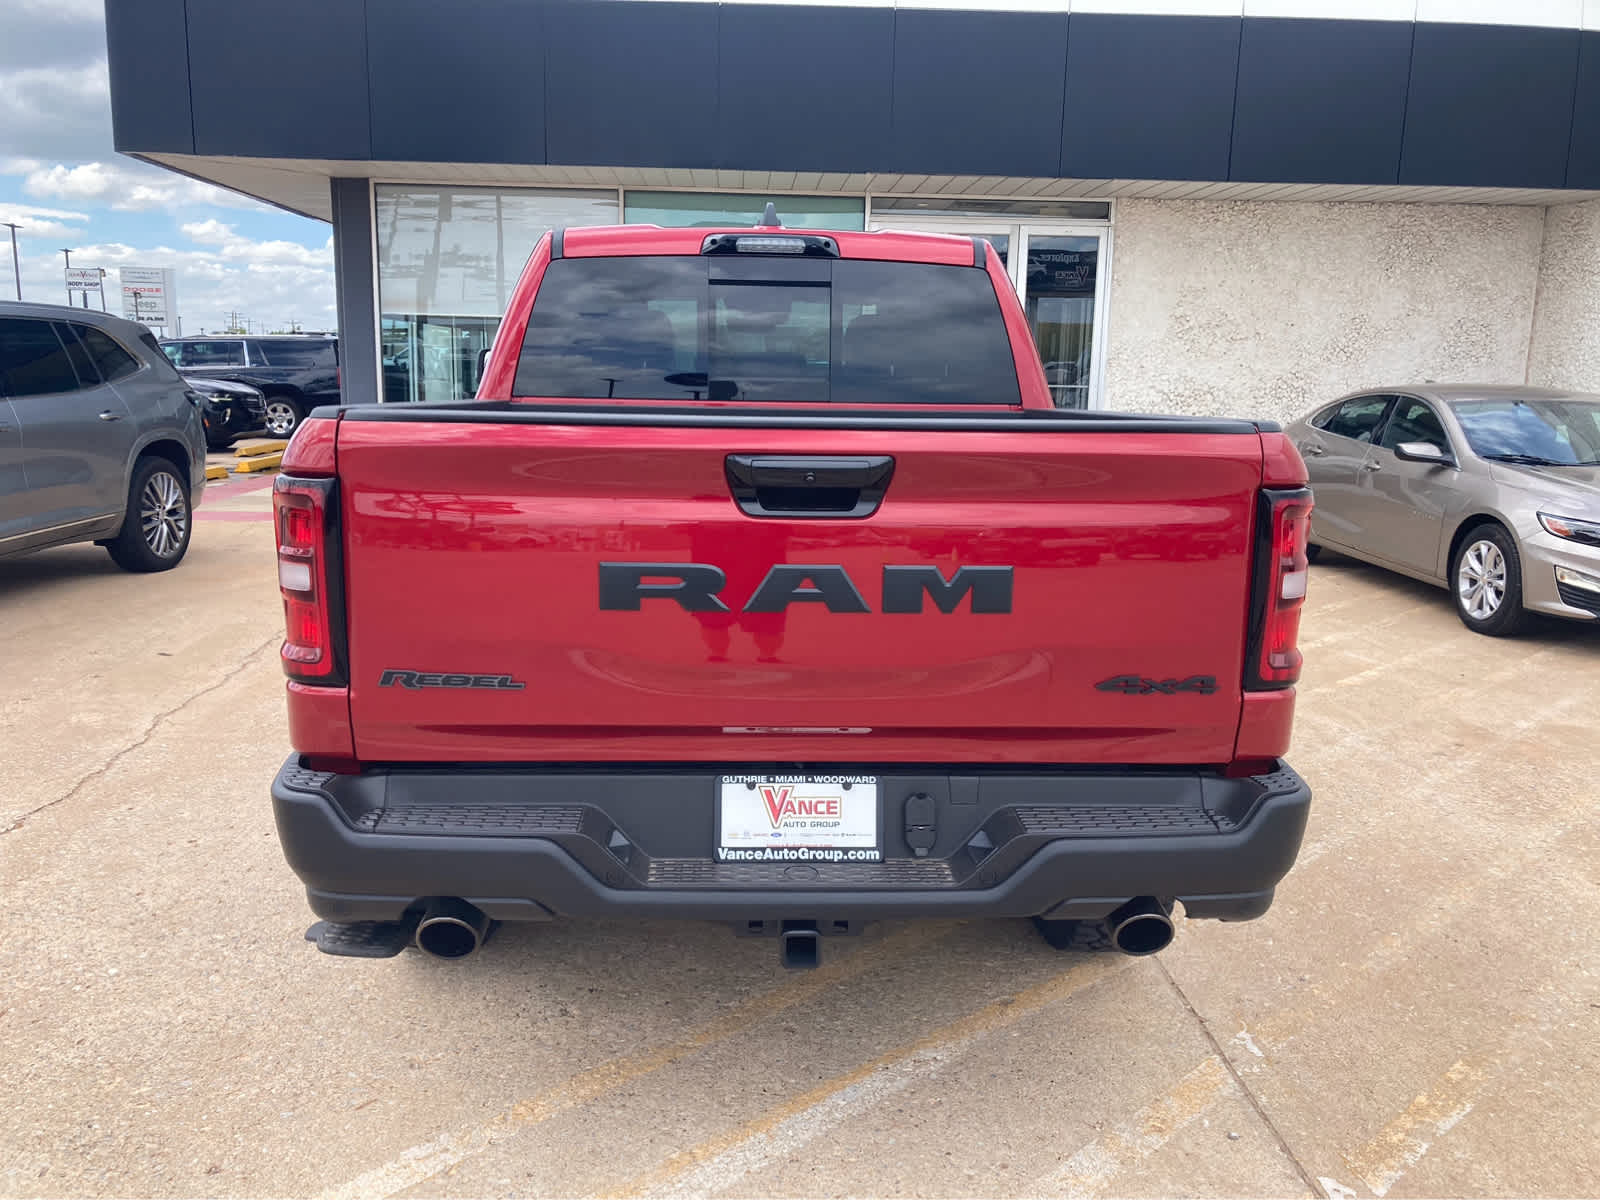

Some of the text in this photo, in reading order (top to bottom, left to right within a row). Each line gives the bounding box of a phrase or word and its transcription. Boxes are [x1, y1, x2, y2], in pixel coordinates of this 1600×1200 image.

[598, 561, 1014, 614] RAM
[378, 669, 525, 690] REBEL
[722, 775, 877, 784] GUTHRIE MIAMI WOODWARD
[759, 786, 841, 828] VANCE
[718, 847, 879, 862] VanceAutoGroup.com
